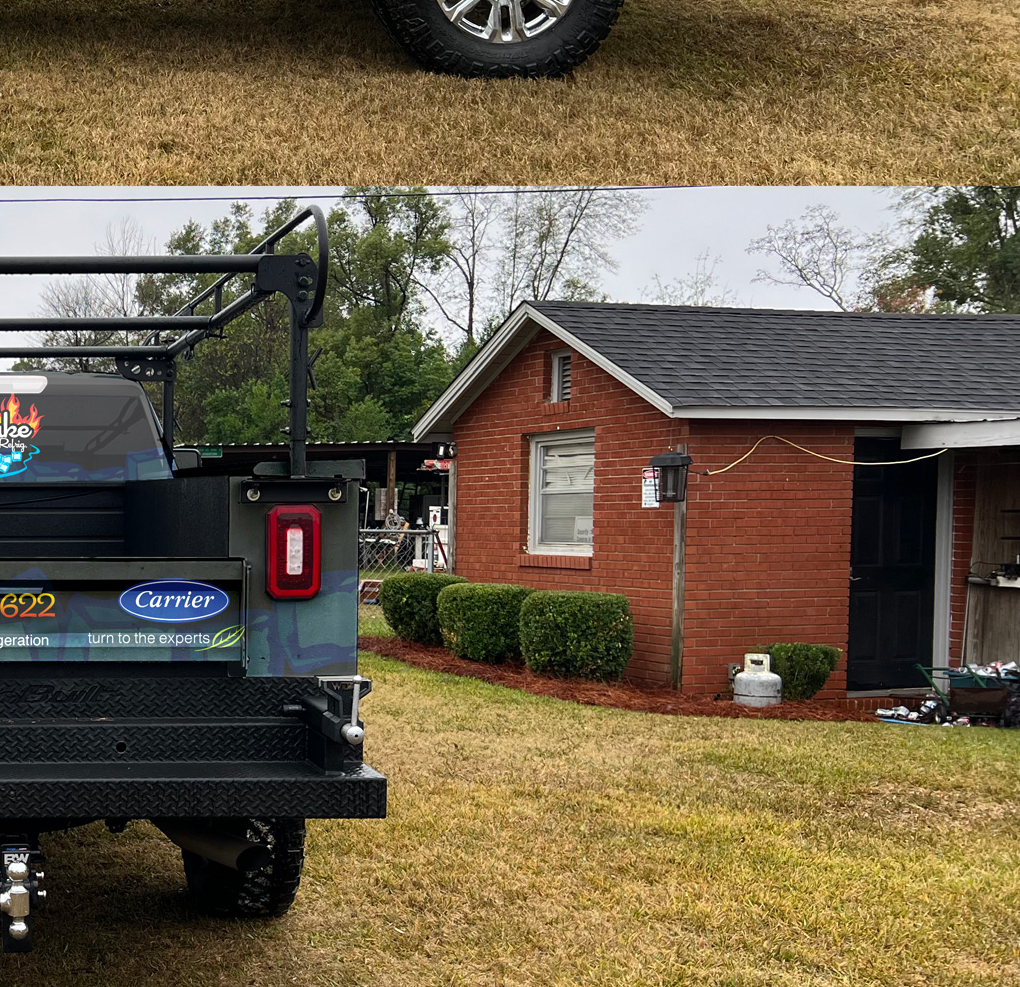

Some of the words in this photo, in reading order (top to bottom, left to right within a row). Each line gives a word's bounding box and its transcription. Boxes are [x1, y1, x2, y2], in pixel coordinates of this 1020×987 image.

[134, 588, 216, 610] Carrier
[87, 633, 115, 645] turn
[117, 632, 131, 645] to
[133, 632, 156, 645] the
[158, 633, 211, 649] experts
